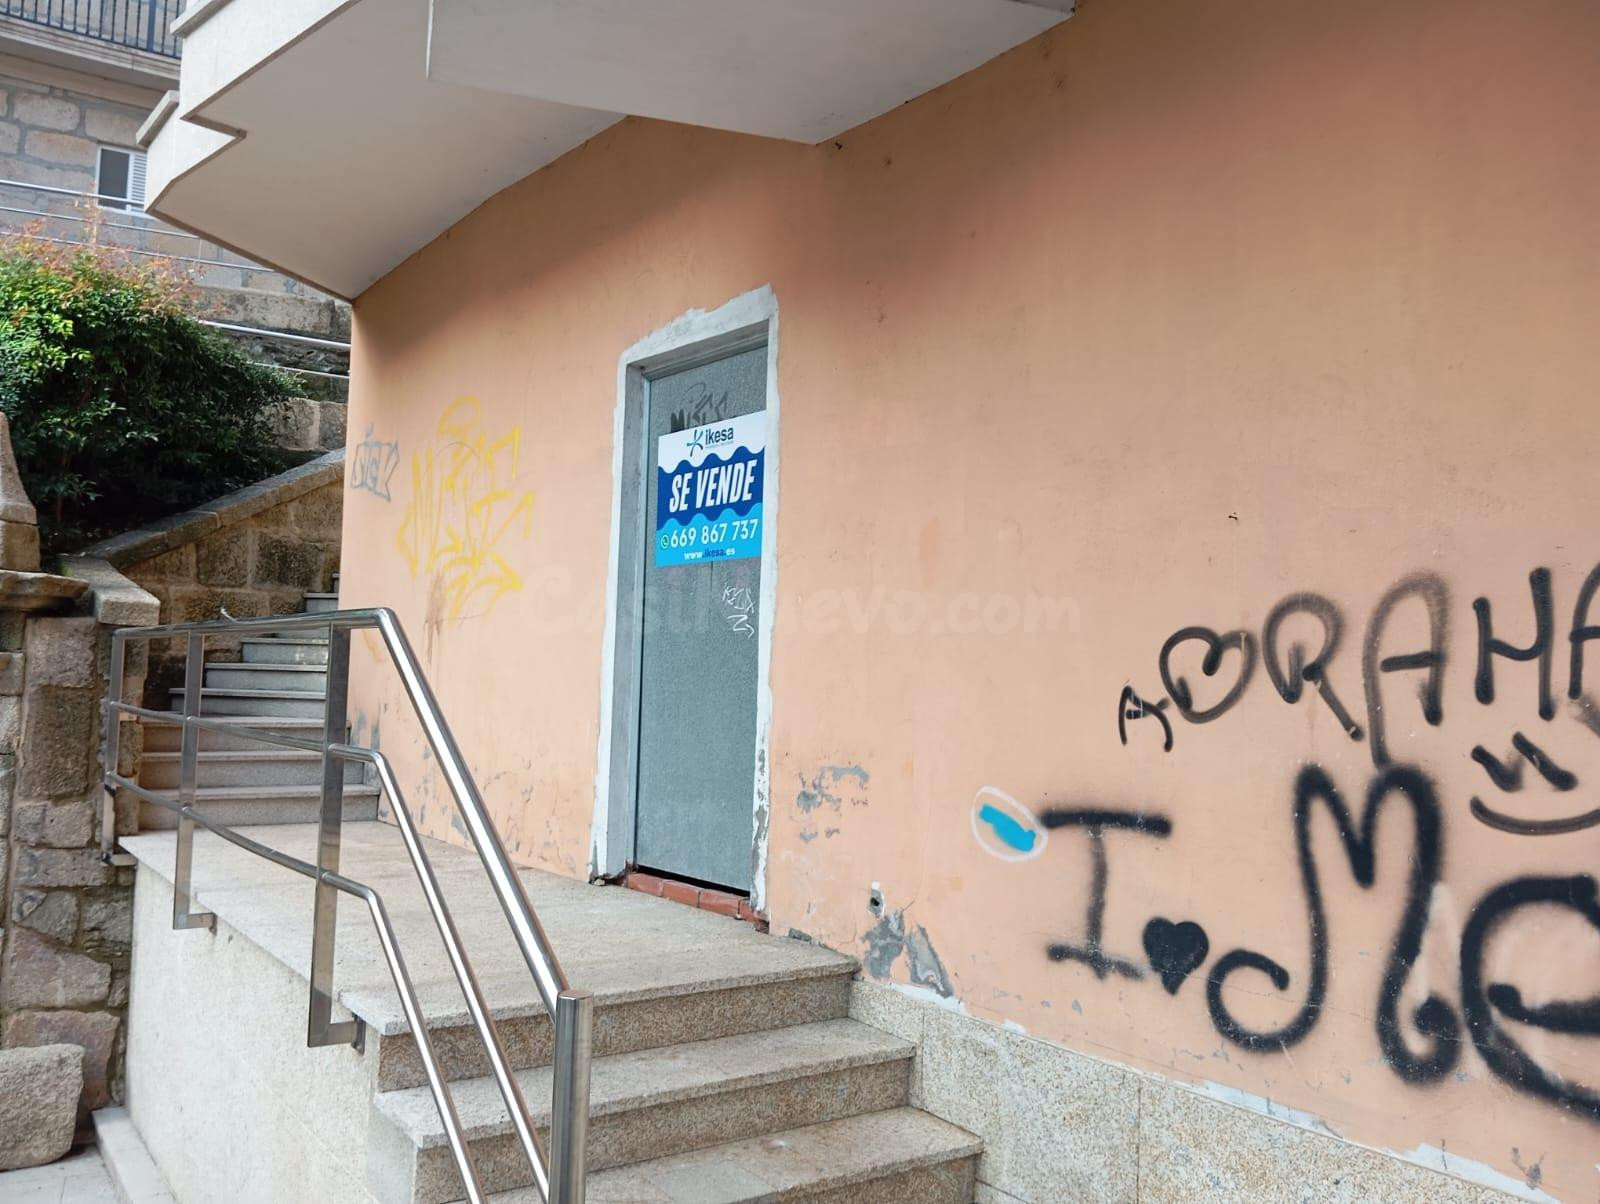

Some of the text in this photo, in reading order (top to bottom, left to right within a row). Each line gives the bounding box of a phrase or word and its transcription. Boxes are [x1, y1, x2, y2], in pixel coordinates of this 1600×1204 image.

[705, 428, 734, 445] ikesa
[669, 459, 757, 513] SE VENDE
[670, 519, 758, 548] 669 867 737
[684, 547, 736, 560] www.ikesa.es
